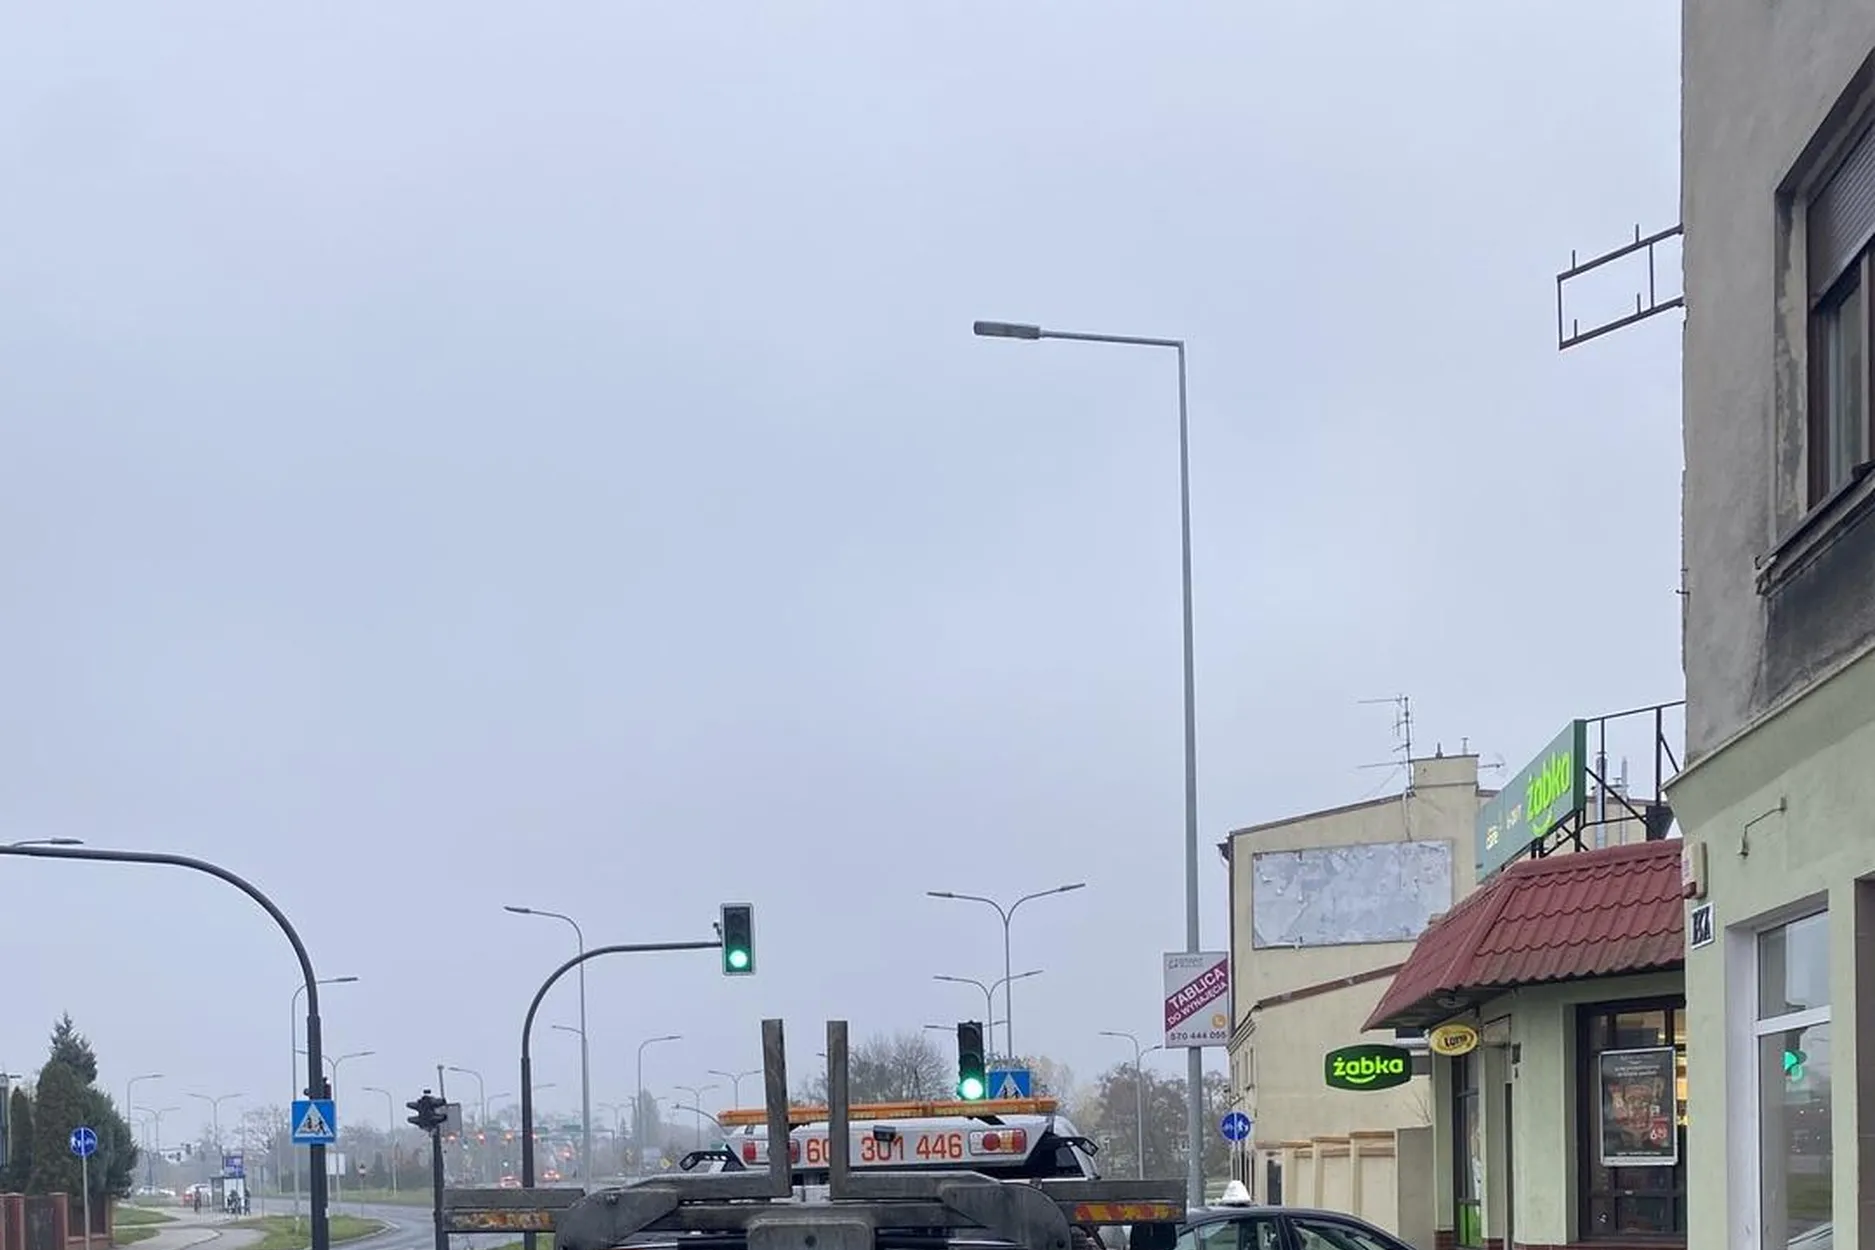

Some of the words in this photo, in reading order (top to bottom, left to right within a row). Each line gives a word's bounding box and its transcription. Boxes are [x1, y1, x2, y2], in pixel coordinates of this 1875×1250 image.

[1526, 751, 1571, 822] żabka
[1168, 968, 1226, 1009] TABLICA
[1167, 1012, 1182, 1025] DO
[1333, 1057, 1404, 1077] żabka
[806, 1138, 830, 1164] 60
[916, 1133, 962, 1159] 446
